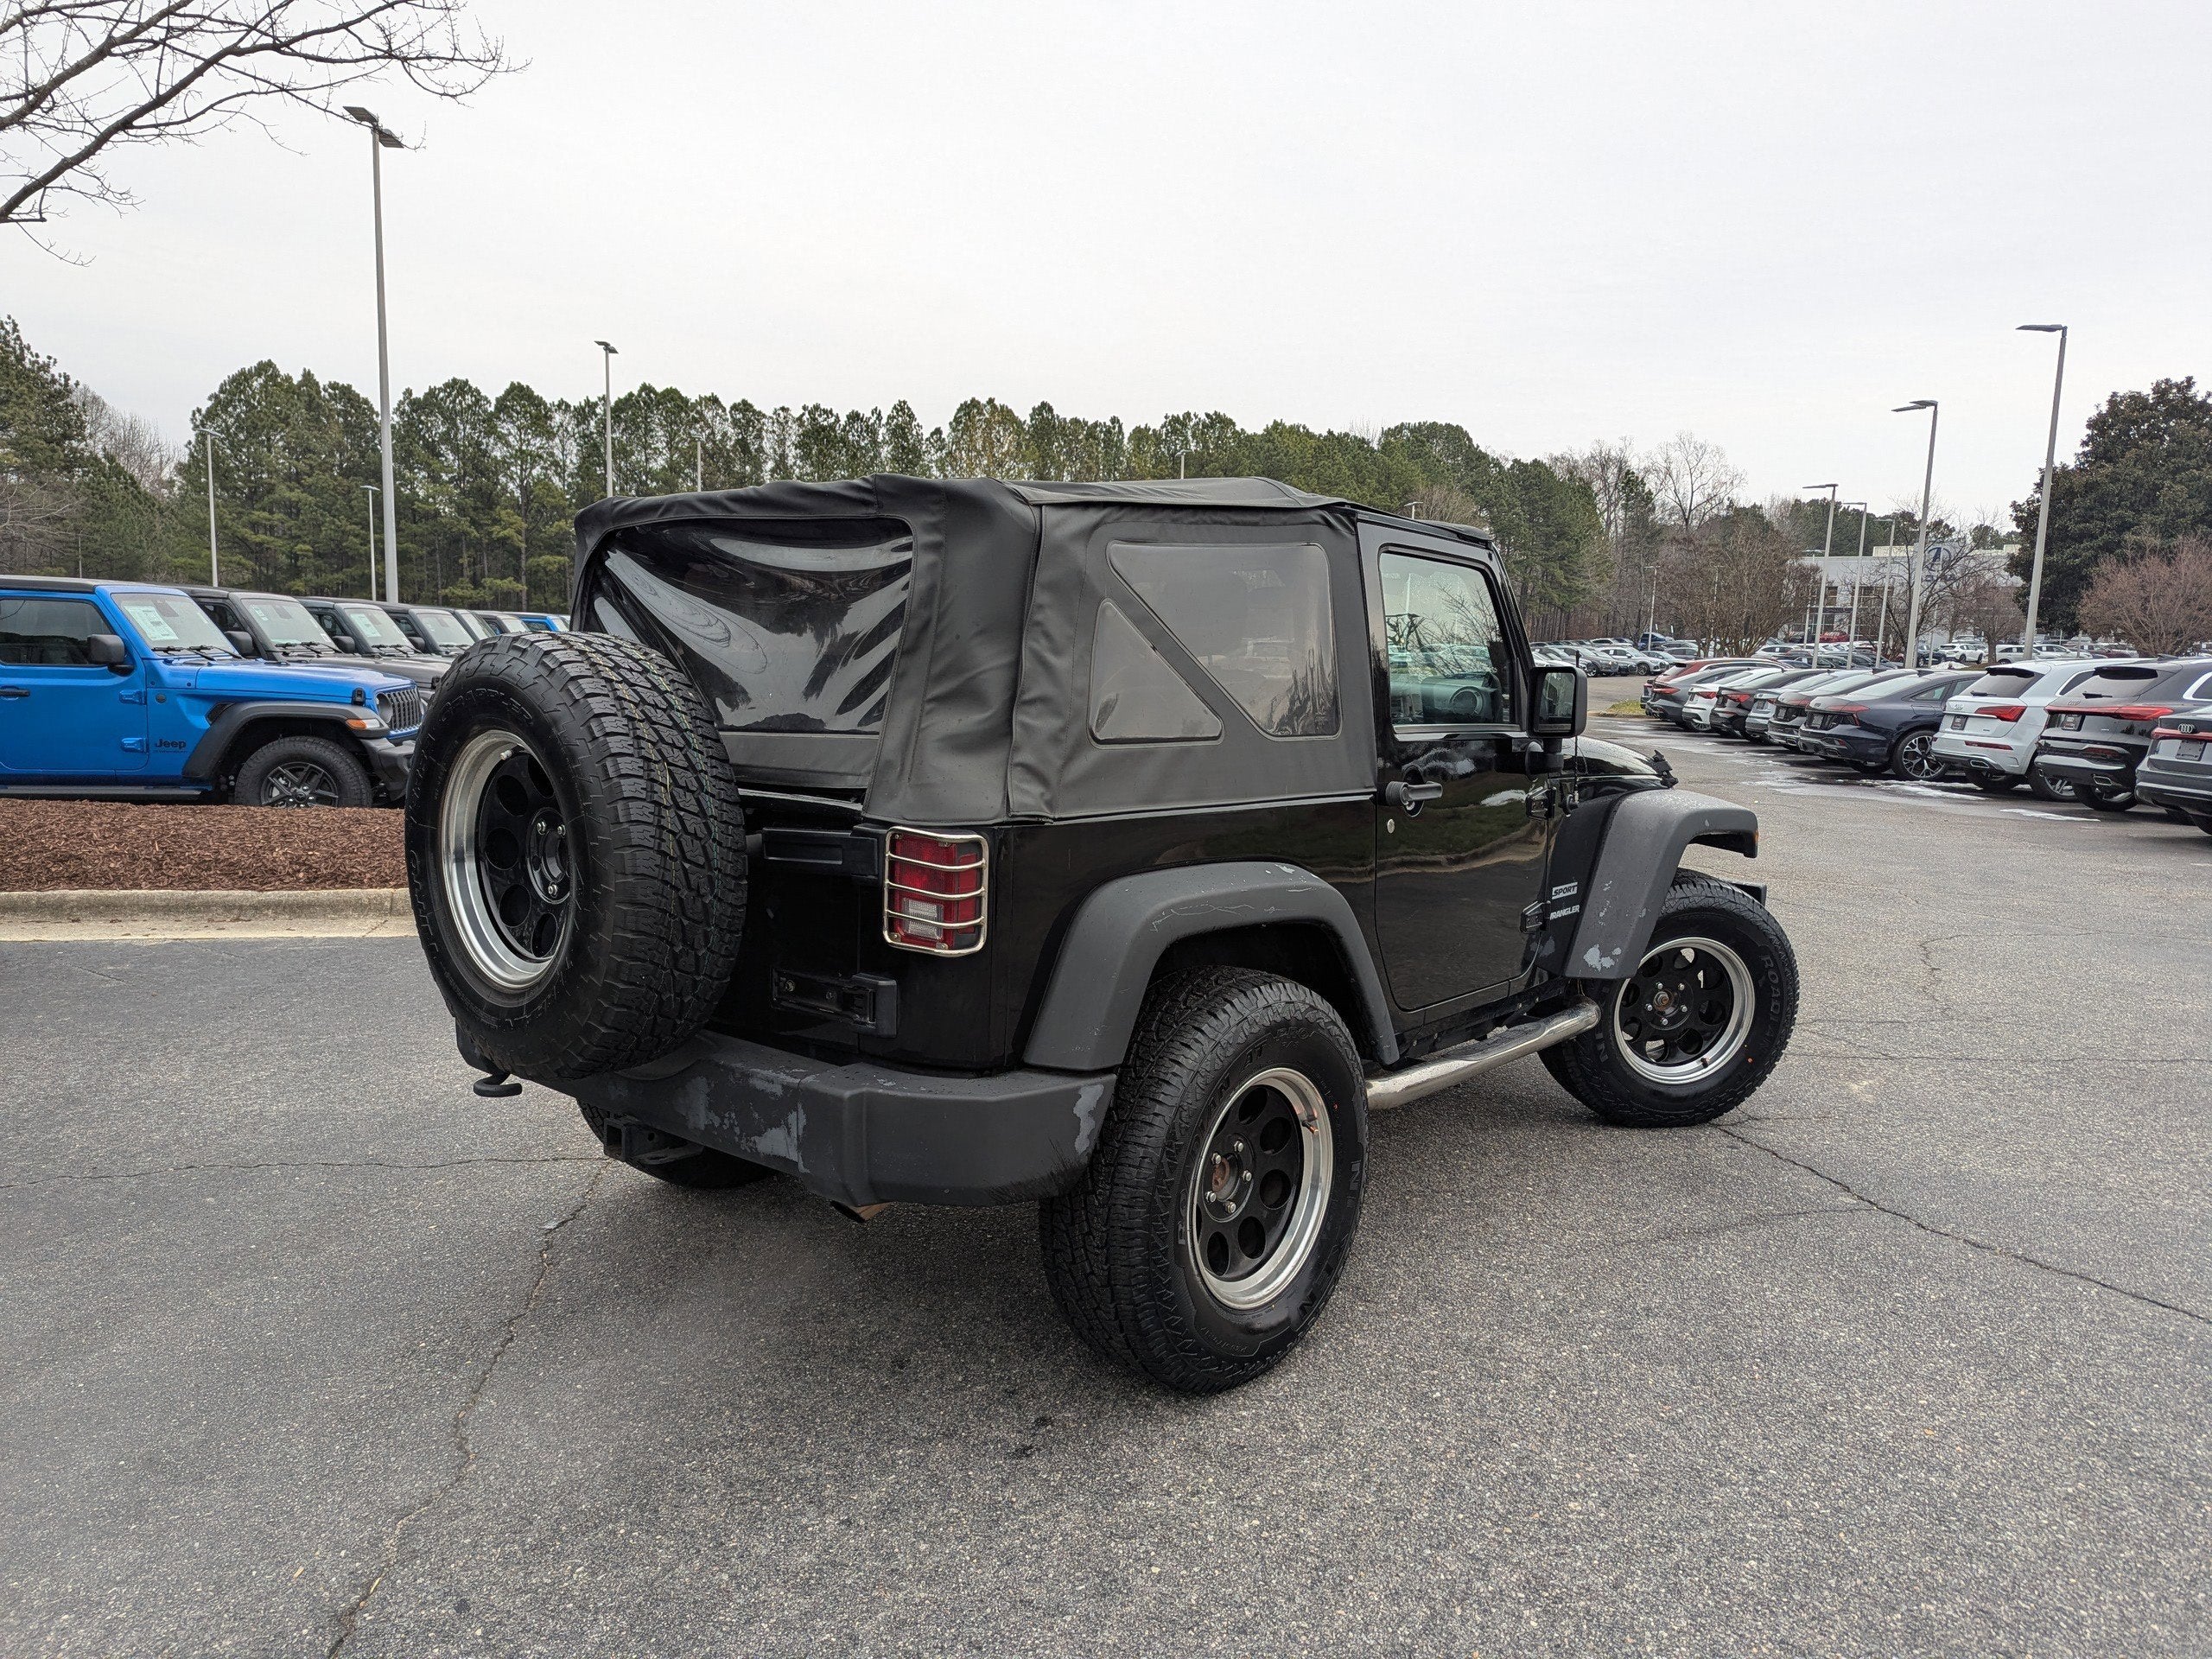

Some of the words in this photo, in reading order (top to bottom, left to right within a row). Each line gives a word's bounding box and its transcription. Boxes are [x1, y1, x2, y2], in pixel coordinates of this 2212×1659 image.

[155, 738, 187, 749] Jeep
[1553, 884, 1576, 896] SPORT
[1549, 904, 1580, 920] RANGLER
